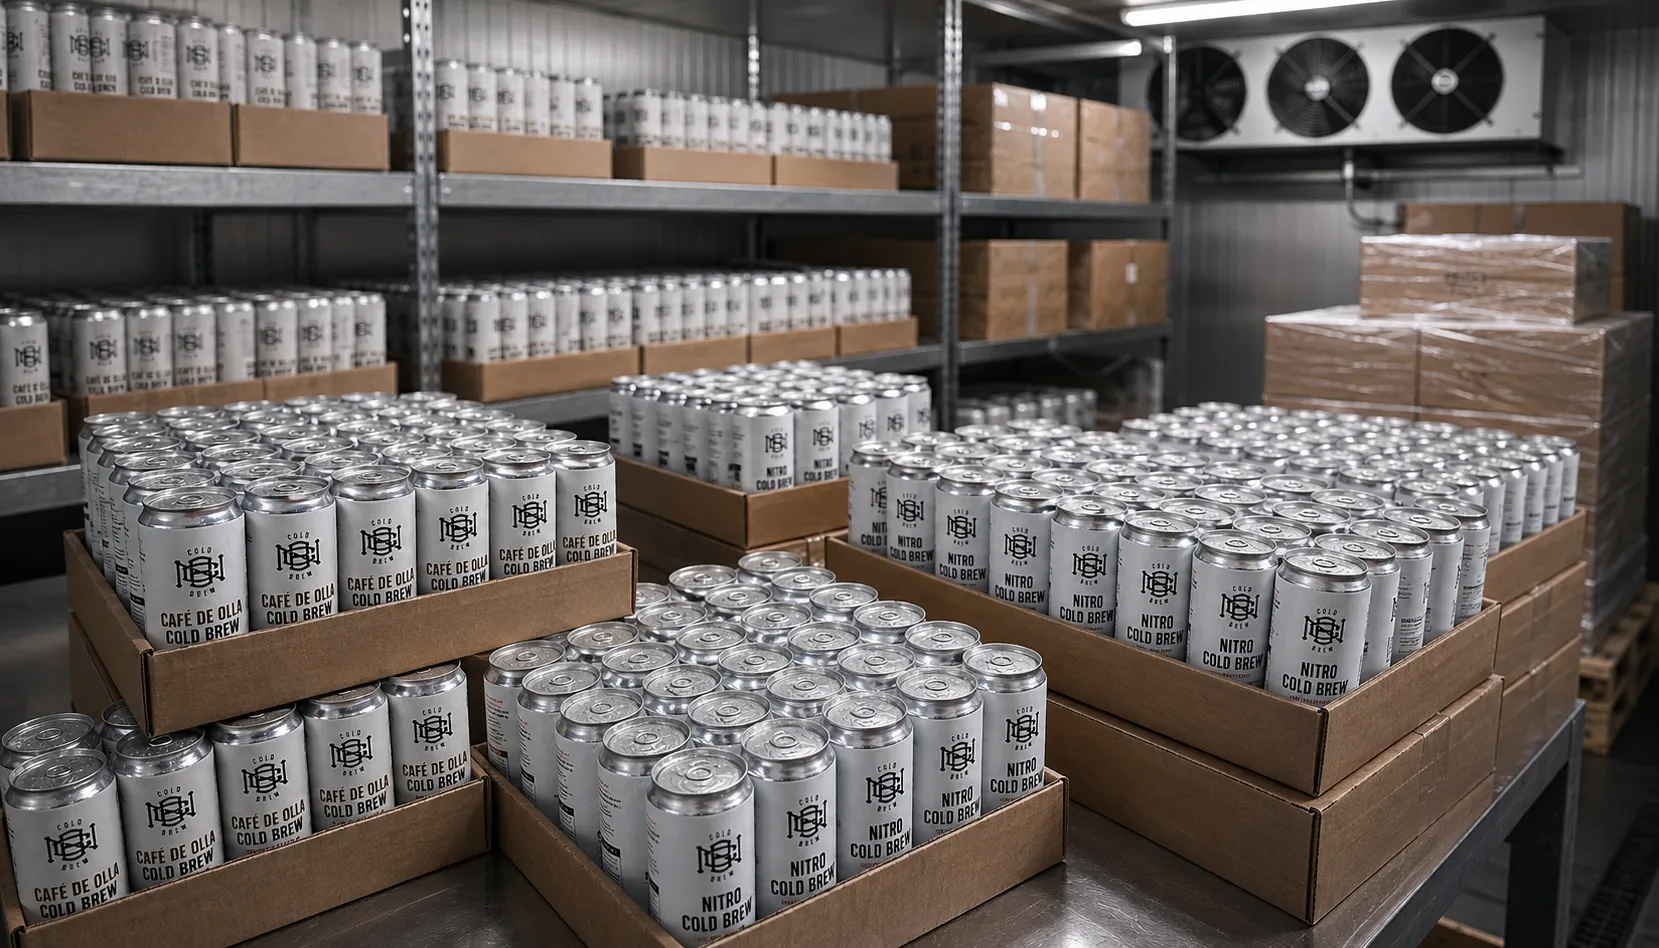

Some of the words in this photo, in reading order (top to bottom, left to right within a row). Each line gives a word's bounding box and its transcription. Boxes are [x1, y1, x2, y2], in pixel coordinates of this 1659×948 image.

[287, 532, 309, 540] COLD
[872, 522, 887, 532] NIT
[563, 534, 585, 548] CAFÉ
[589, 535, 601, 547] DE
[861, 534, 881, 546] COLD
[898, 535, 922, 548] NITRO
[187, 547, 212, 555] COLD
[500, 546, 524, 561] CAFÉ
[528, 546, 540, 558] DE
[567, 550, 591, 562] COLD
[890, 547, 906, 561] COLD
[909, 550, 935, 562] BREW
[948, 553, 974, 566] NITRO
[426, 560, 451, 576] CAFÉ
[456, 562, 469, 573] DE
[504, 562, 529, 575] COLD
[940, 564, 957, 579] COLD
[961, 568, 986, 580] BREW
[348, 573, 374, 591] CAFÉ
[378, 574, 392, 588] DE
[396, 568, 414, 585] OLLA
[431, 577, 458, 591] COLD
[1005, 573, 1033, 588] NITRO
[261, 592, 290, 608] CAFÉ
[295, 592, 310, 606] DE
[314, 583, 334, 602] OLLA
[352, 592, 380, 607] COLD
[386, 584, 412, 604] BREW
[995, 585, 1014, 602] COLD
[1018, 590, 1045, 603] BREW
[1073, 594, 1103, 608] NITRO
[161, 609, 191, 627] CAFÉ
[197, 608, 213, 624] DE
[218, 600, 242, 620] OLLA
[267, 610, 298, 625] COLD
[303, 601, 332, 622] BREW
[1060, 607, 1083, 623] COLD
[1088, 609, 1114, 624] BREW
[1142, 614, 1173, 629] NITRO
[166, 628, 200, 644] COLD
[205, 618, 239, 641] BREW
[1127, 626, 1151, 644] COLD
[1156, 630, 1183, 645] BREW
[1220, 638, 1253, 653] NITRO
[1203, 651, 1230, 670] COLD
[1235, 654, 1263, 670] BREW
[1301, 662, 1337, 679] NITRO
[1282, 674, 1311, 694] COLD
[1316, 679, 1348, 696] BREW
[253, 754, 274, 764] COLD
[402, 761, 427, 777] CAFÉ
[432, 763, 444, 775] DE
[448, 751, 467, 770] OLLA
[1007, 757, 1036, 777] NITRO
[320, 785, 345, 802] CAFÉ
[350, 787, 363, 800] DE
[368, 774, 388, 795] OLLA
[407, 776, 434, 792] COLD
[439, 767, 465, 788] BREW
[991, 778, 1018, 794] COLD
[157, 786, 181, 796] COLD
[799, 795, 818, 805] COLD
[942, 786, 973, 807] NITRO
[324, 802, 352, 818] COLD
[358, 790, 386, 814] BREW
[231, 810, 258, 829] CAFÉ
[265, 812, 279, 827] DE
[283, 799, 305, 821] OLLA
[924, 809, 953, 824] COLD
[57, 819, 82, 830] COLD
[237, 827, 267, 845] COLD
[272, 817, 303, 840] BREW
[869, 818, 903, 840] NITRO
[709, 829, 731, 840] COLD
[851, 842, 881, 858] COLD
[886, 828, 911, 856] BREW
[137, 847, 165, 865] CAFÉ
[170, 845, 186, 860] DE
[191, 830, 215, 854] OLLA
[143, 864, 174, 881] COLD
[180, 848, 213, 875] BREW
[790, 852, 826, 877] NITRO
[34, 883, 67, 902] CAFÉ
[73, 879, 89, 895] DE
[94, 862, 119, 888] OLLA
[771, 880, 804, 896] COLD
[809, 862, 835, 892] BREW
[40, 901, 75, 919] COLD
[82, 881, 117, 910] BREW
[702, 887, 742, 913] NITRO
[682, 915, 717, 932] COLD
[723, 895, 752, 929] BREW
